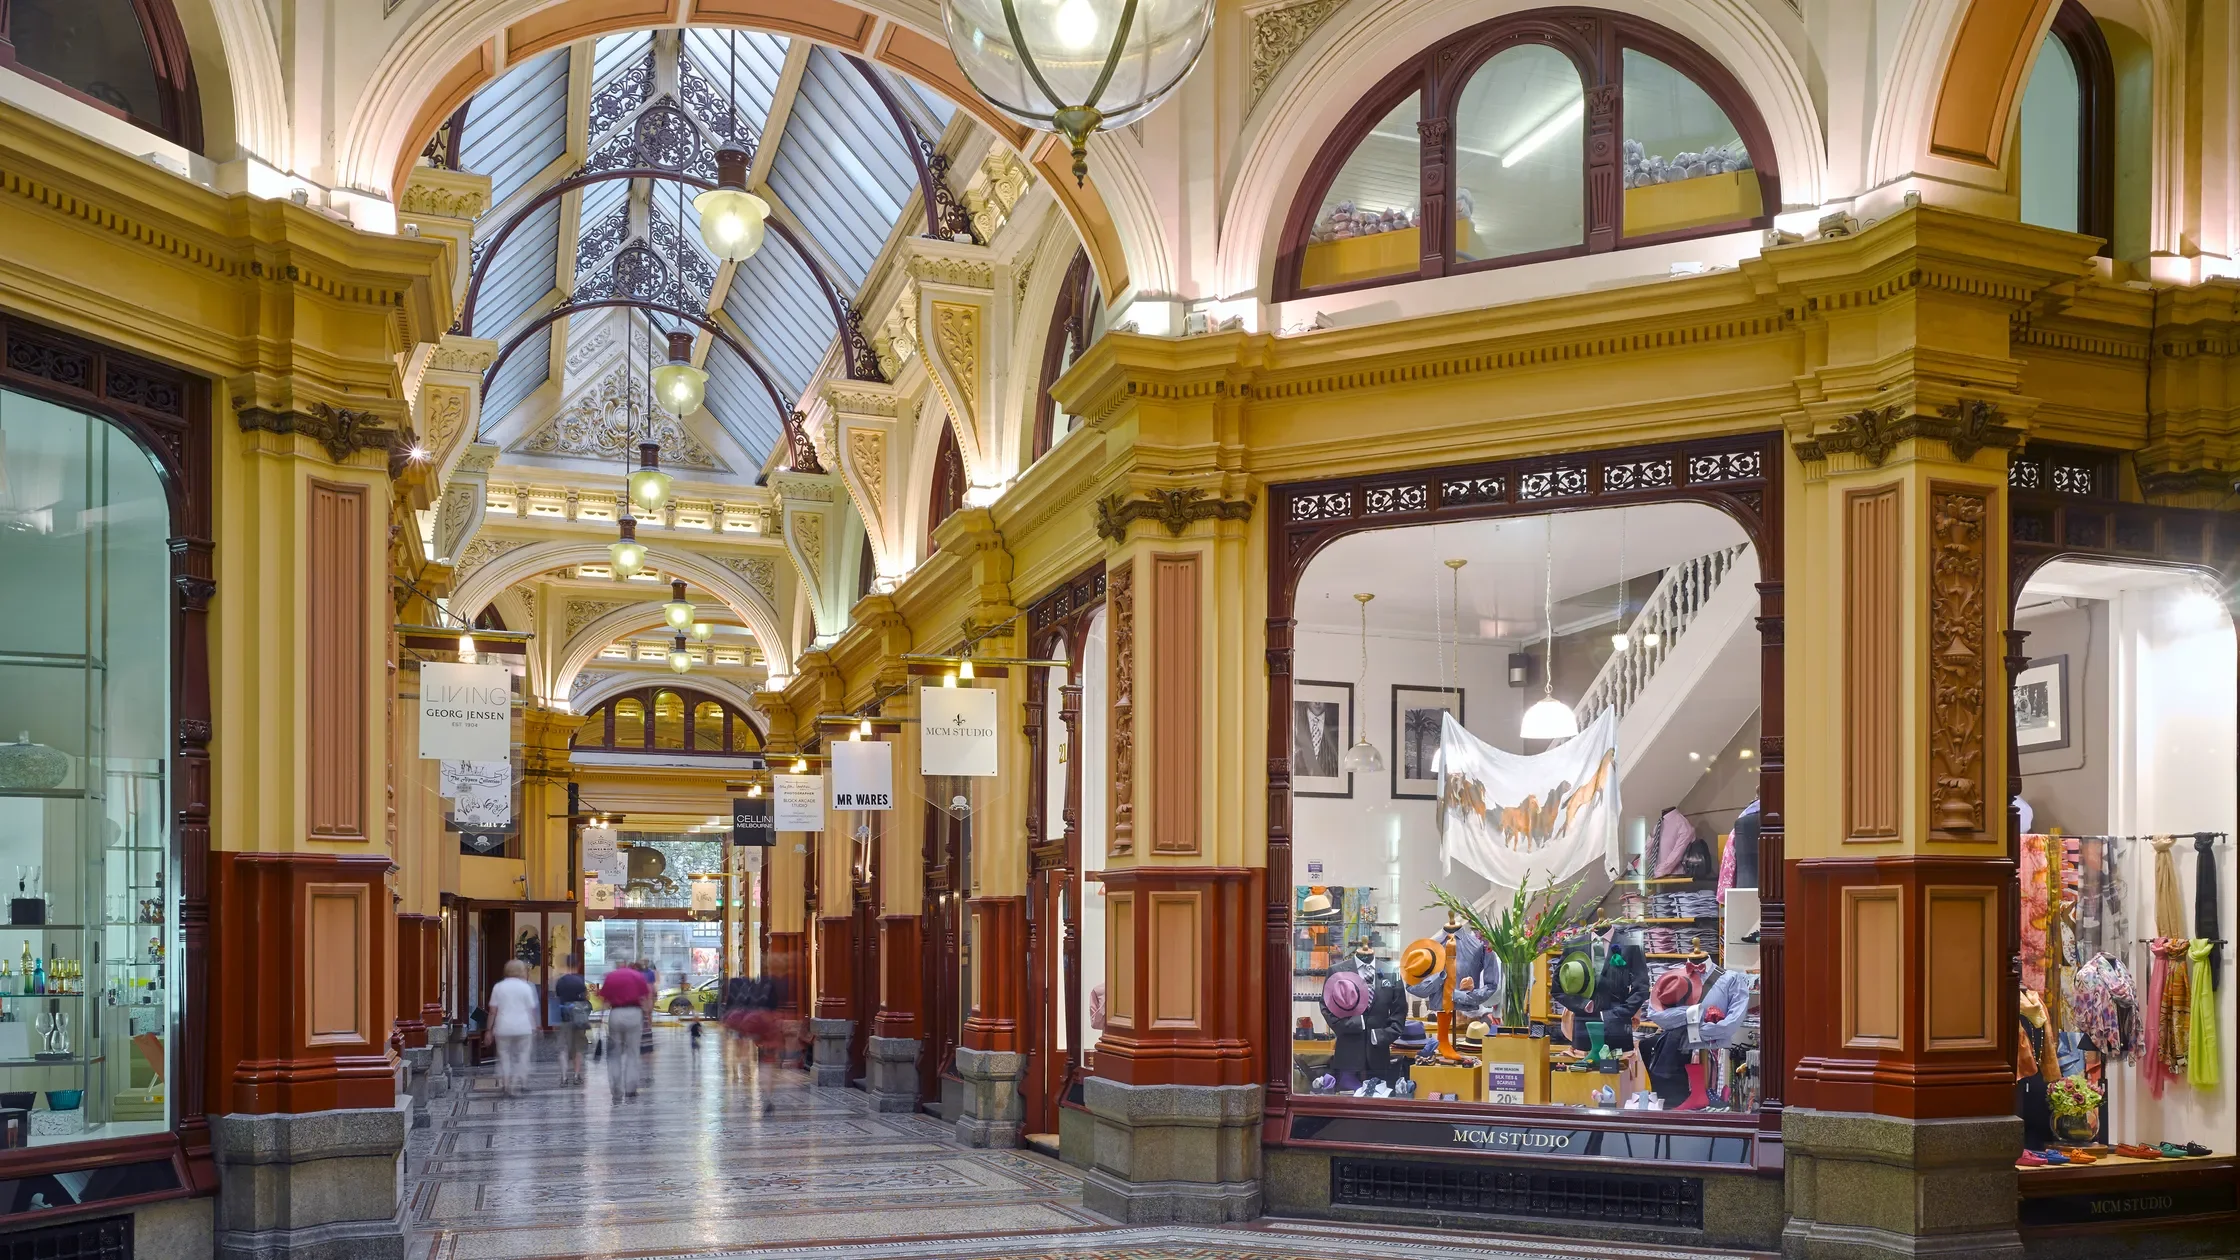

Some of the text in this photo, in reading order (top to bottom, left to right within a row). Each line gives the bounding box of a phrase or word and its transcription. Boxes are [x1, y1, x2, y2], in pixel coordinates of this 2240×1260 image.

[426, 684, 507, 706] LIVING
[426, 708, 505, 720] GEORG JENSEN
[926, 727, 993, 737] MCM STUDIO
[837, 794, 888, 805] MR WARES
[736, 814, 774, 823] CELLINI
[1452, 1129, 1570, 1148] MCM STUDIO
[2090, 1196, 2173, 1214] MCM STUDIO
